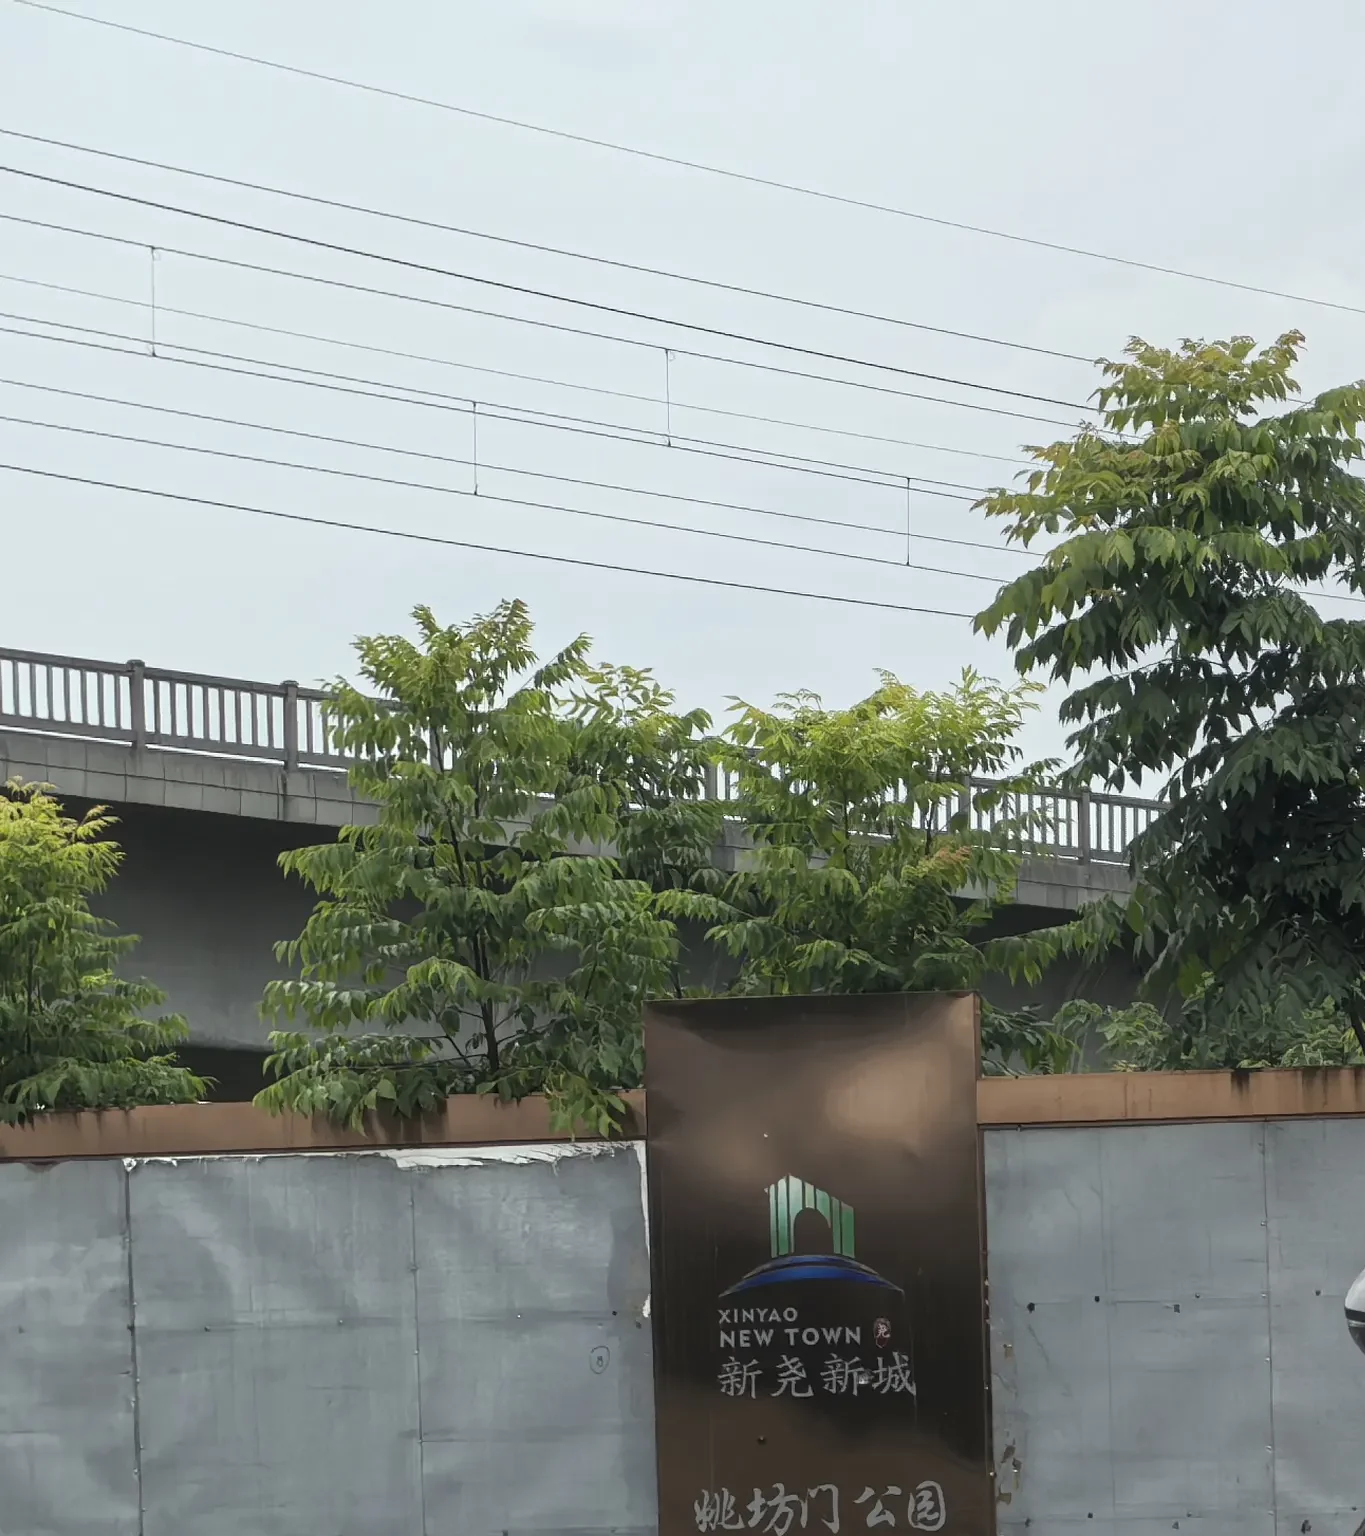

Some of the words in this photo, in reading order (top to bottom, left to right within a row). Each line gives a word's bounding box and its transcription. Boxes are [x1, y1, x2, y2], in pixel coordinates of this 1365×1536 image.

[718, 1308, 797, 1324] XINYAO
[720, 1329, 773, 1347] NEW
[784, 1327, 860, 1345] TOWN
[718, 1352, 916, 1398] 新尧新城
[694, 1481, 946, 1536] 姚坊门公园
